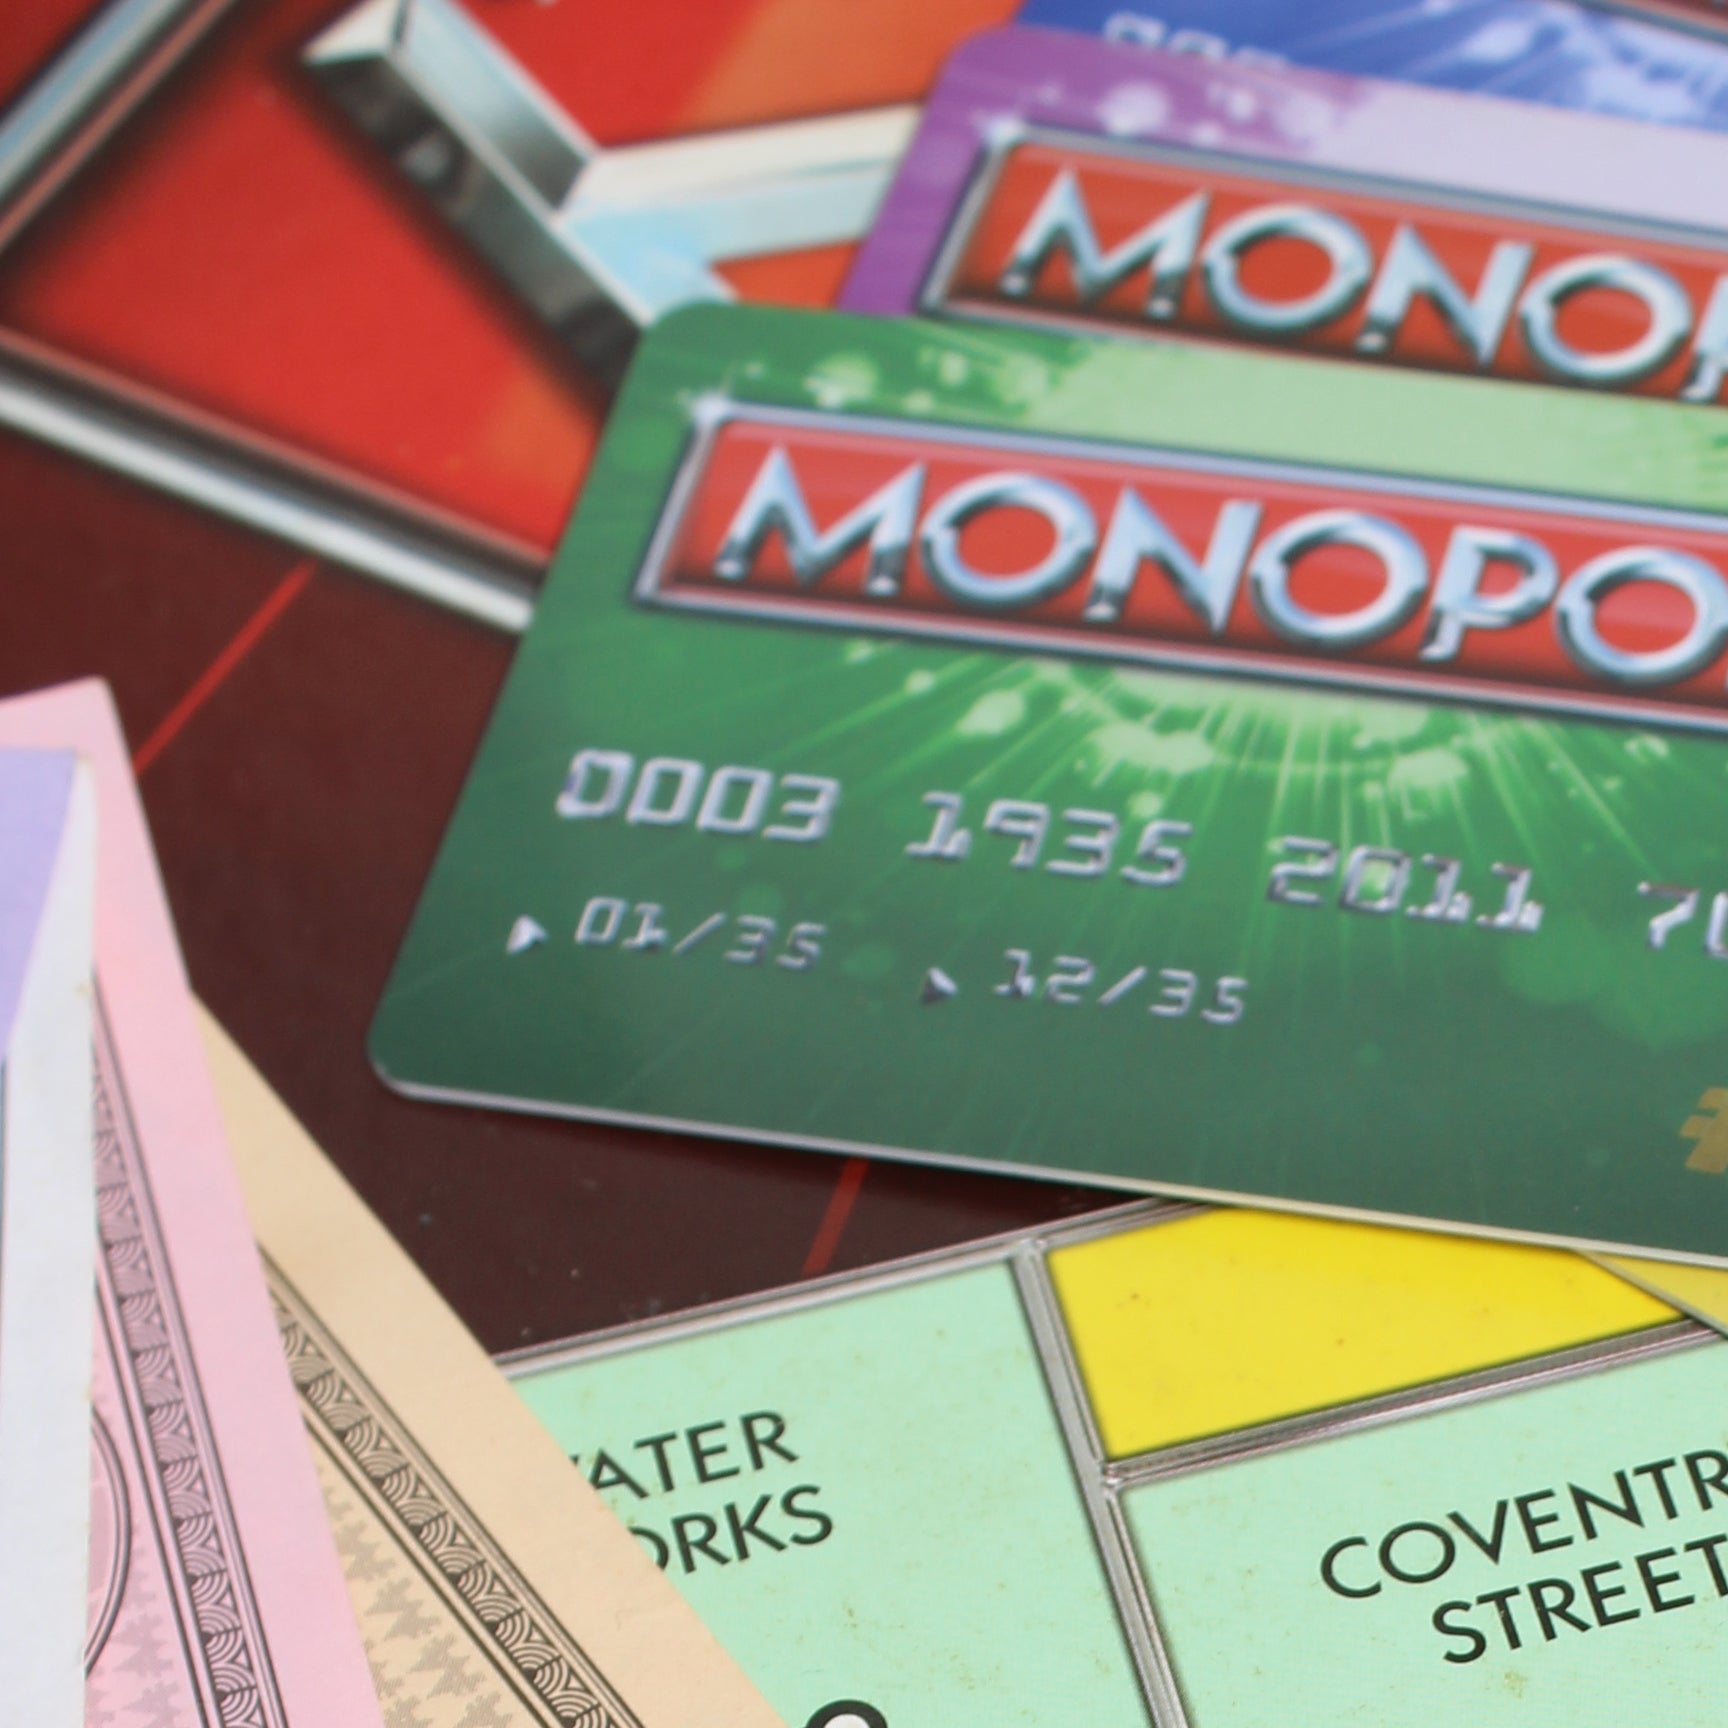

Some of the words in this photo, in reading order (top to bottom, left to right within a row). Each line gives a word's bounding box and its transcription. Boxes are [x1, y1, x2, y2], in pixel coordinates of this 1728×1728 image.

[556, 747, 841, 843] 0003
[904, 791, 1193, 887] 1935
[1266, 834, 1545, 931] 2011
[575, 896, 827, 970] 01/35
[994, 949, 1248, 1024] 12/35
[570, 1409, 799, 1499] ATER
